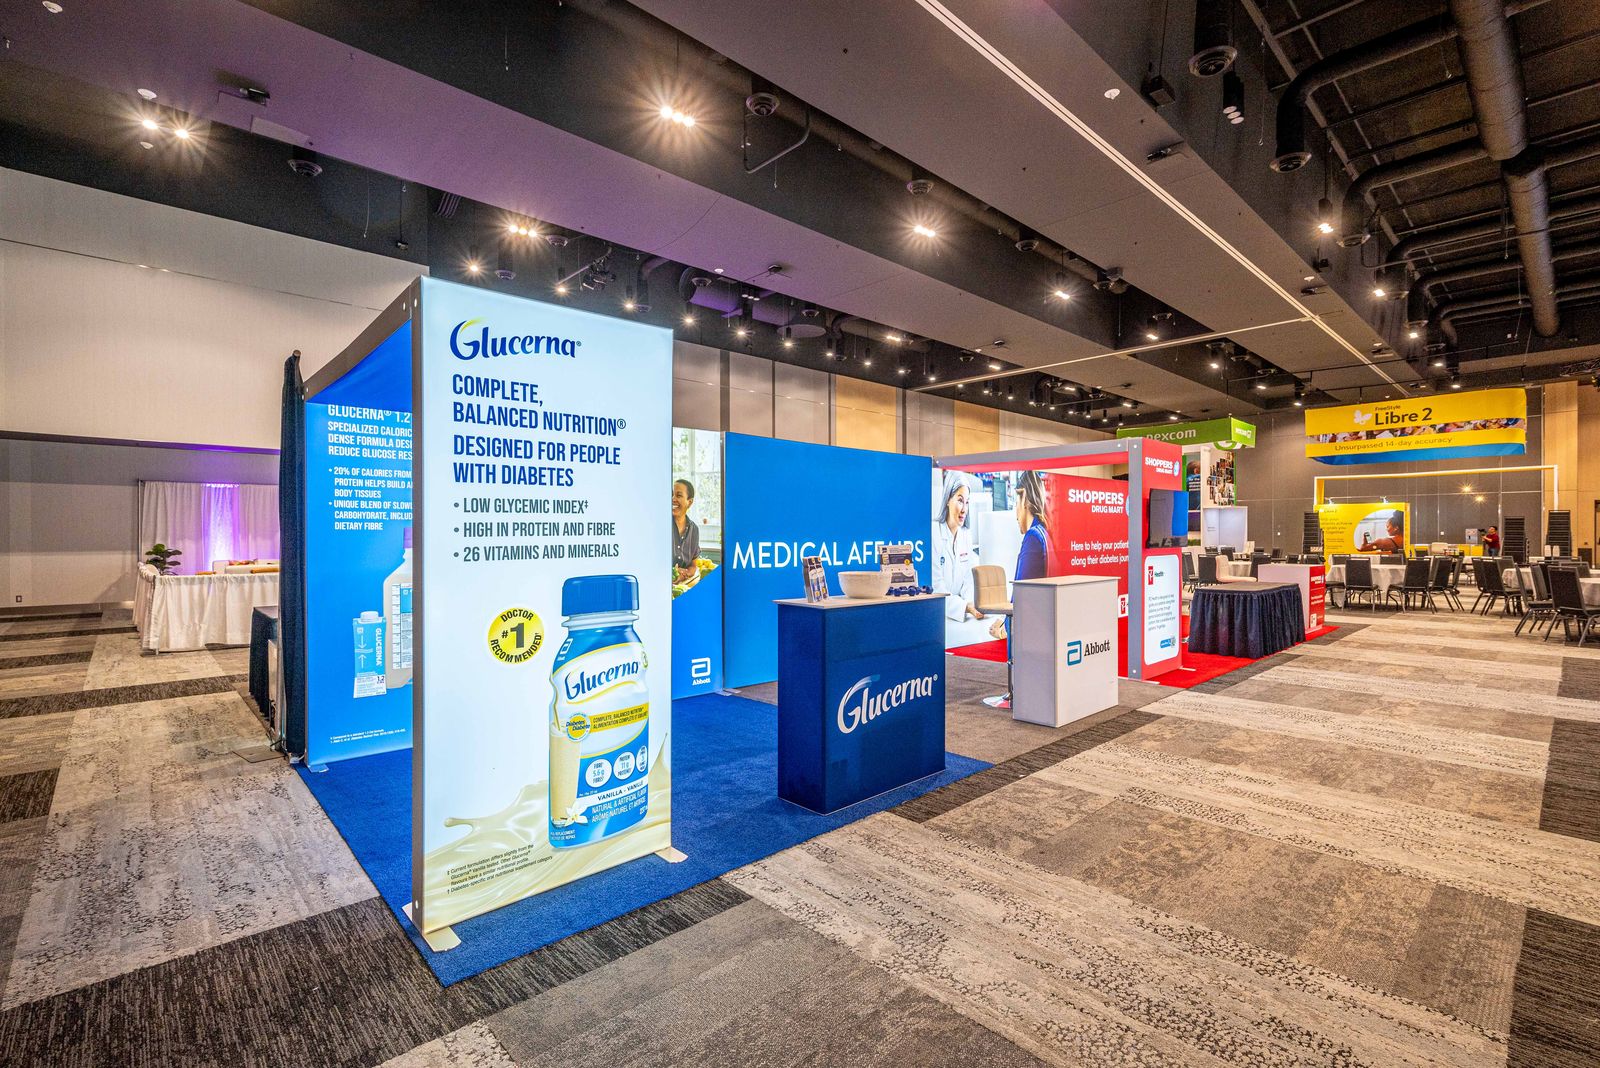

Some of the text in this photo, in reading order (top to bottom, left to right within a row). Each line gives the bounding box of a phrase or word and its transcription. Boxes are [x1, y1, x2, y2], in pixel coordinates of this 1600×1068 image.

[453, 374, 543, 407] COMPLETE,
[453, 401, 626, 436] BALANCED NUTRITION®
[1375, 407, 1433, 426] Libre 2
[328, 421, 412, 437] SPECIALIZED CALORIC
[328, 434, 355, 445] DENSE
[356, 436, 394, 448] FORMULA
[1335, 441, 1384, 451] Unsurpassed
[1414, 437, 1453, 446] accuracy
[328, 446, 360, 457] REDUCE
[362, 448, 397, 460] GLUCOSE
[453, 434, 621, 465] DESIGNED FOR PEOPLE
[1145, 456, 1173, 469] SHOPPERS
[333, 467, 350, 475] 20%
[351, 468, 360, 476] OF
[361, 468, 393, 478] CALORIES
[453, 462, 574, 487] WITH DIABETES
[334, 478, 363, 487] PROTEIN
[364, 479, 386, 488] HELPS
[387, 480, 406, 489] BUILD
[334, 489, 381, 498] BODY TISSUES
[1068, 488, 1124, 505] SHOPPERS
[333, 500, 359, 509] UNIQUE
[360, 501, 381, 509] BLEND
[383, 501, 392, 510] OF
[463, 498, 490, 513] LOW
[494, 498, 550, 514] GLYCEMIC
[1091, 505, 1124, 514] DRUG MART
[334, 511, 389, 520] CARBOHYDRATE,
[334, 522, 383, 530] DIETARY FIBRE
[463, 522, 616, 537] HIGH IN PROTEIN AND FIBRE
[463, 543, 619, 562] 26 VITAMINS AND MINERALS
[1070, 540, 1084, 551] Here
[1085, 541, 1091, 551] to
[1091, 541, 1102, 552] help
[1103, 542, 1114, 552] your
[732, 541, 843, 569] MEDICAL
[1070, 555, 1086, 567] along
[1087, 554, 1099, 565] their
[1099, 553, 1119, 565] diabetes
[500, 609, 534, 622] DOCTOR
[501, 622, 525, 649] #1
[375, 627, 383, 666] GLUCERNA
[1084, 640, 1110, 656] Abbott
[692, 677, 711, 686] Abbott
[597, 789, 623, 801] VANILLA
[451, 865, 467, 874] Current
[467, 857, 490, 868] formulation
[515, 860, 537, 872] supplement
[537, 855, 553, 864] category
[482, 868, 496, 876] similar
